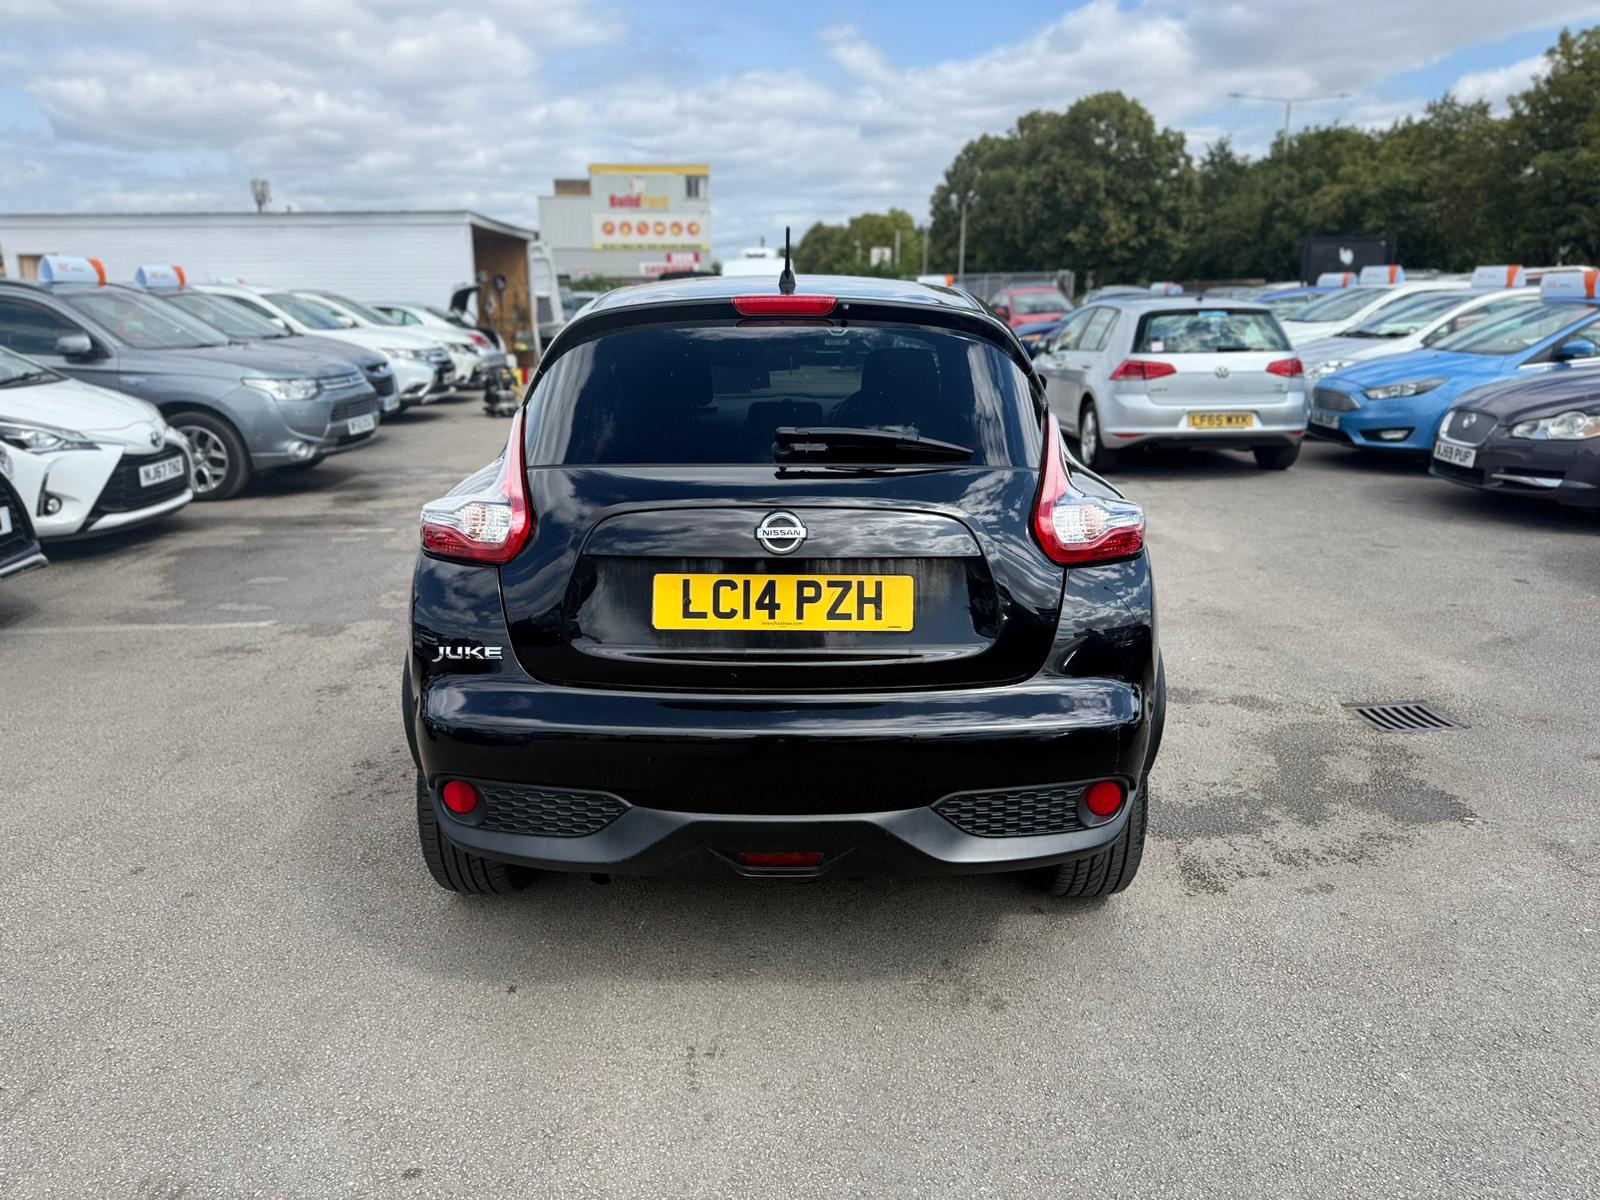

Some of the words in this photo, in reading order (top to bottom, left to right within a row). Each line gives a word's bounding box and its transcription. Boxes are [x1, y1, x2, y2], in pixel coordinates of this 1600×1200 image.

[1191, 413, 1223, 426] LF65
[762, 529, 802, 537] NISSAN
[682, 578, 781, 620] LC14
[796, 580, 883, 621] PZH
[431, 646, 503, 663] JUKE
